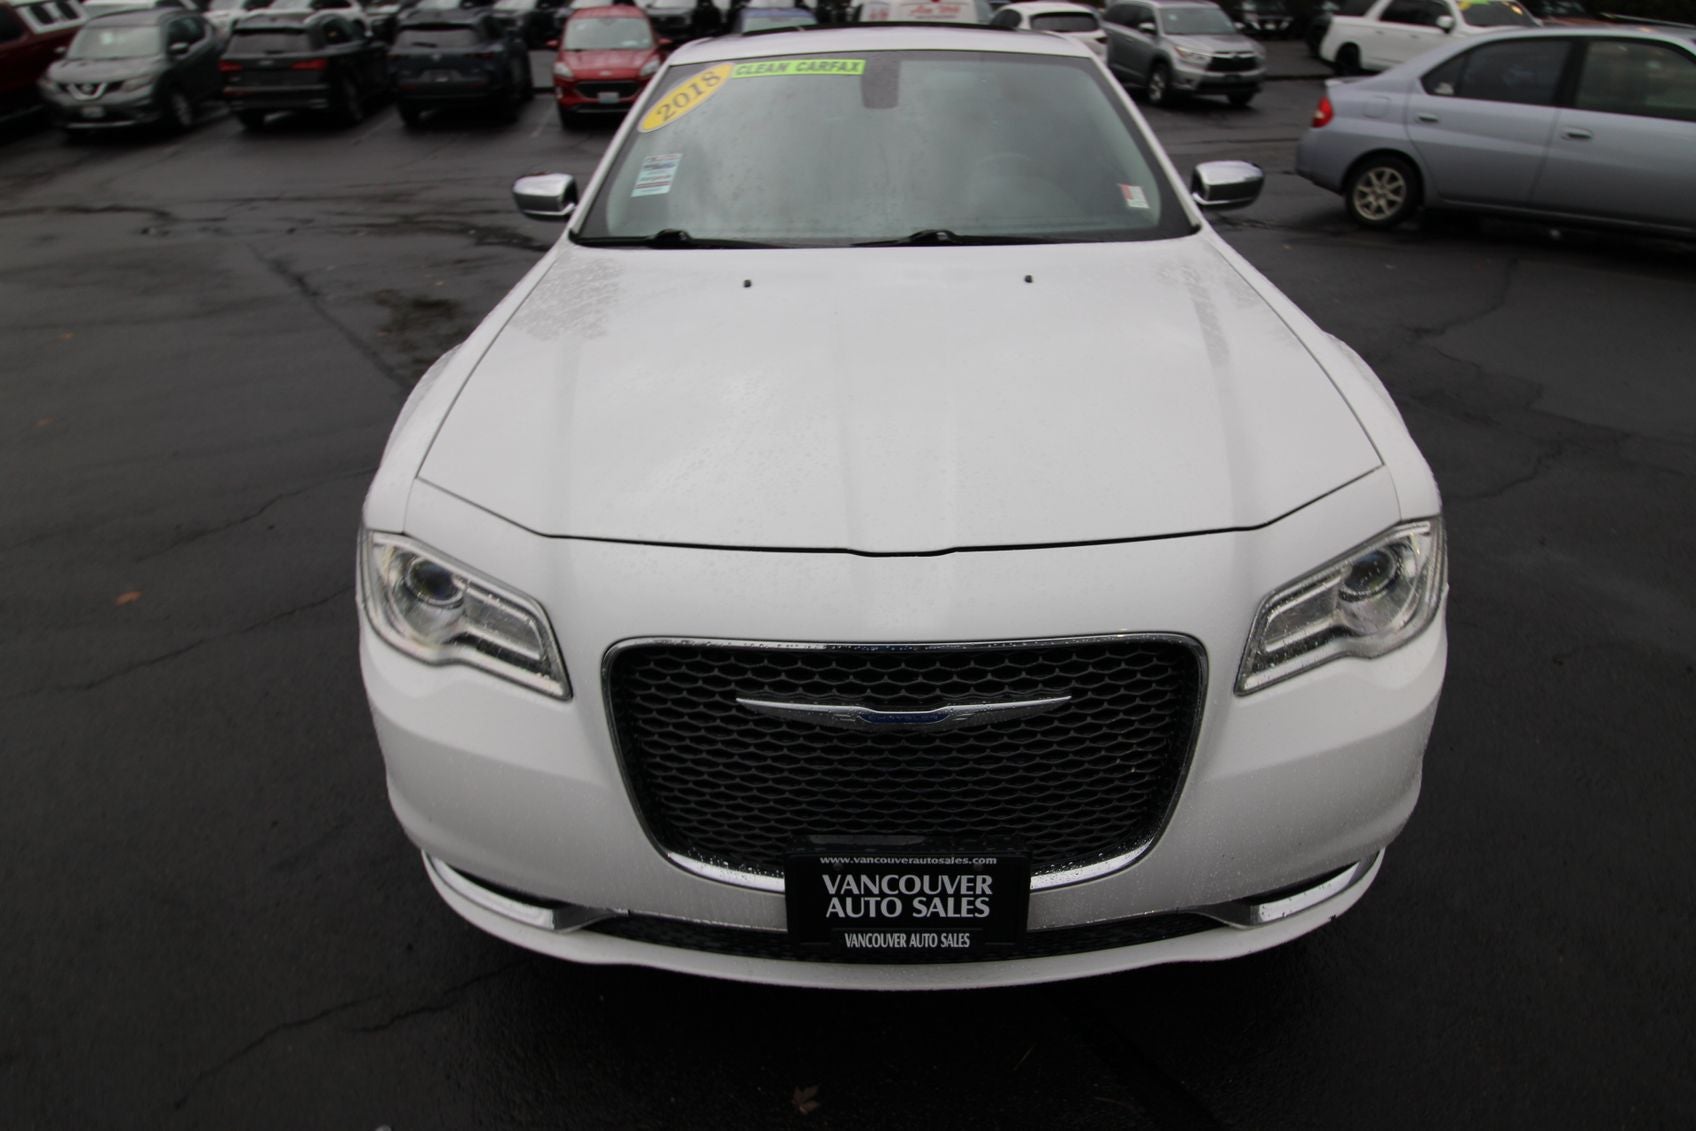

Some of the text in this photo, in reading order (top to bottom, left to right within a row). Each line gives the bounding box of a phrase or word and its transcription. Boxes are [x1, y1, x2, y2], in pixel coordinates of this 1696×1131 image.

[735, 60, 860, 76] CLEAN CARFAX
[657, 70, 721, 121] 2018
[820, 856, 997, 865] www.vancouverautosales.com
[822, 874, 993, 895] VANCOUVER
[825, 896, 991, 918] AUTO SALES
[844, 932, 971, 948] VANCOUVER AUTO SALES
